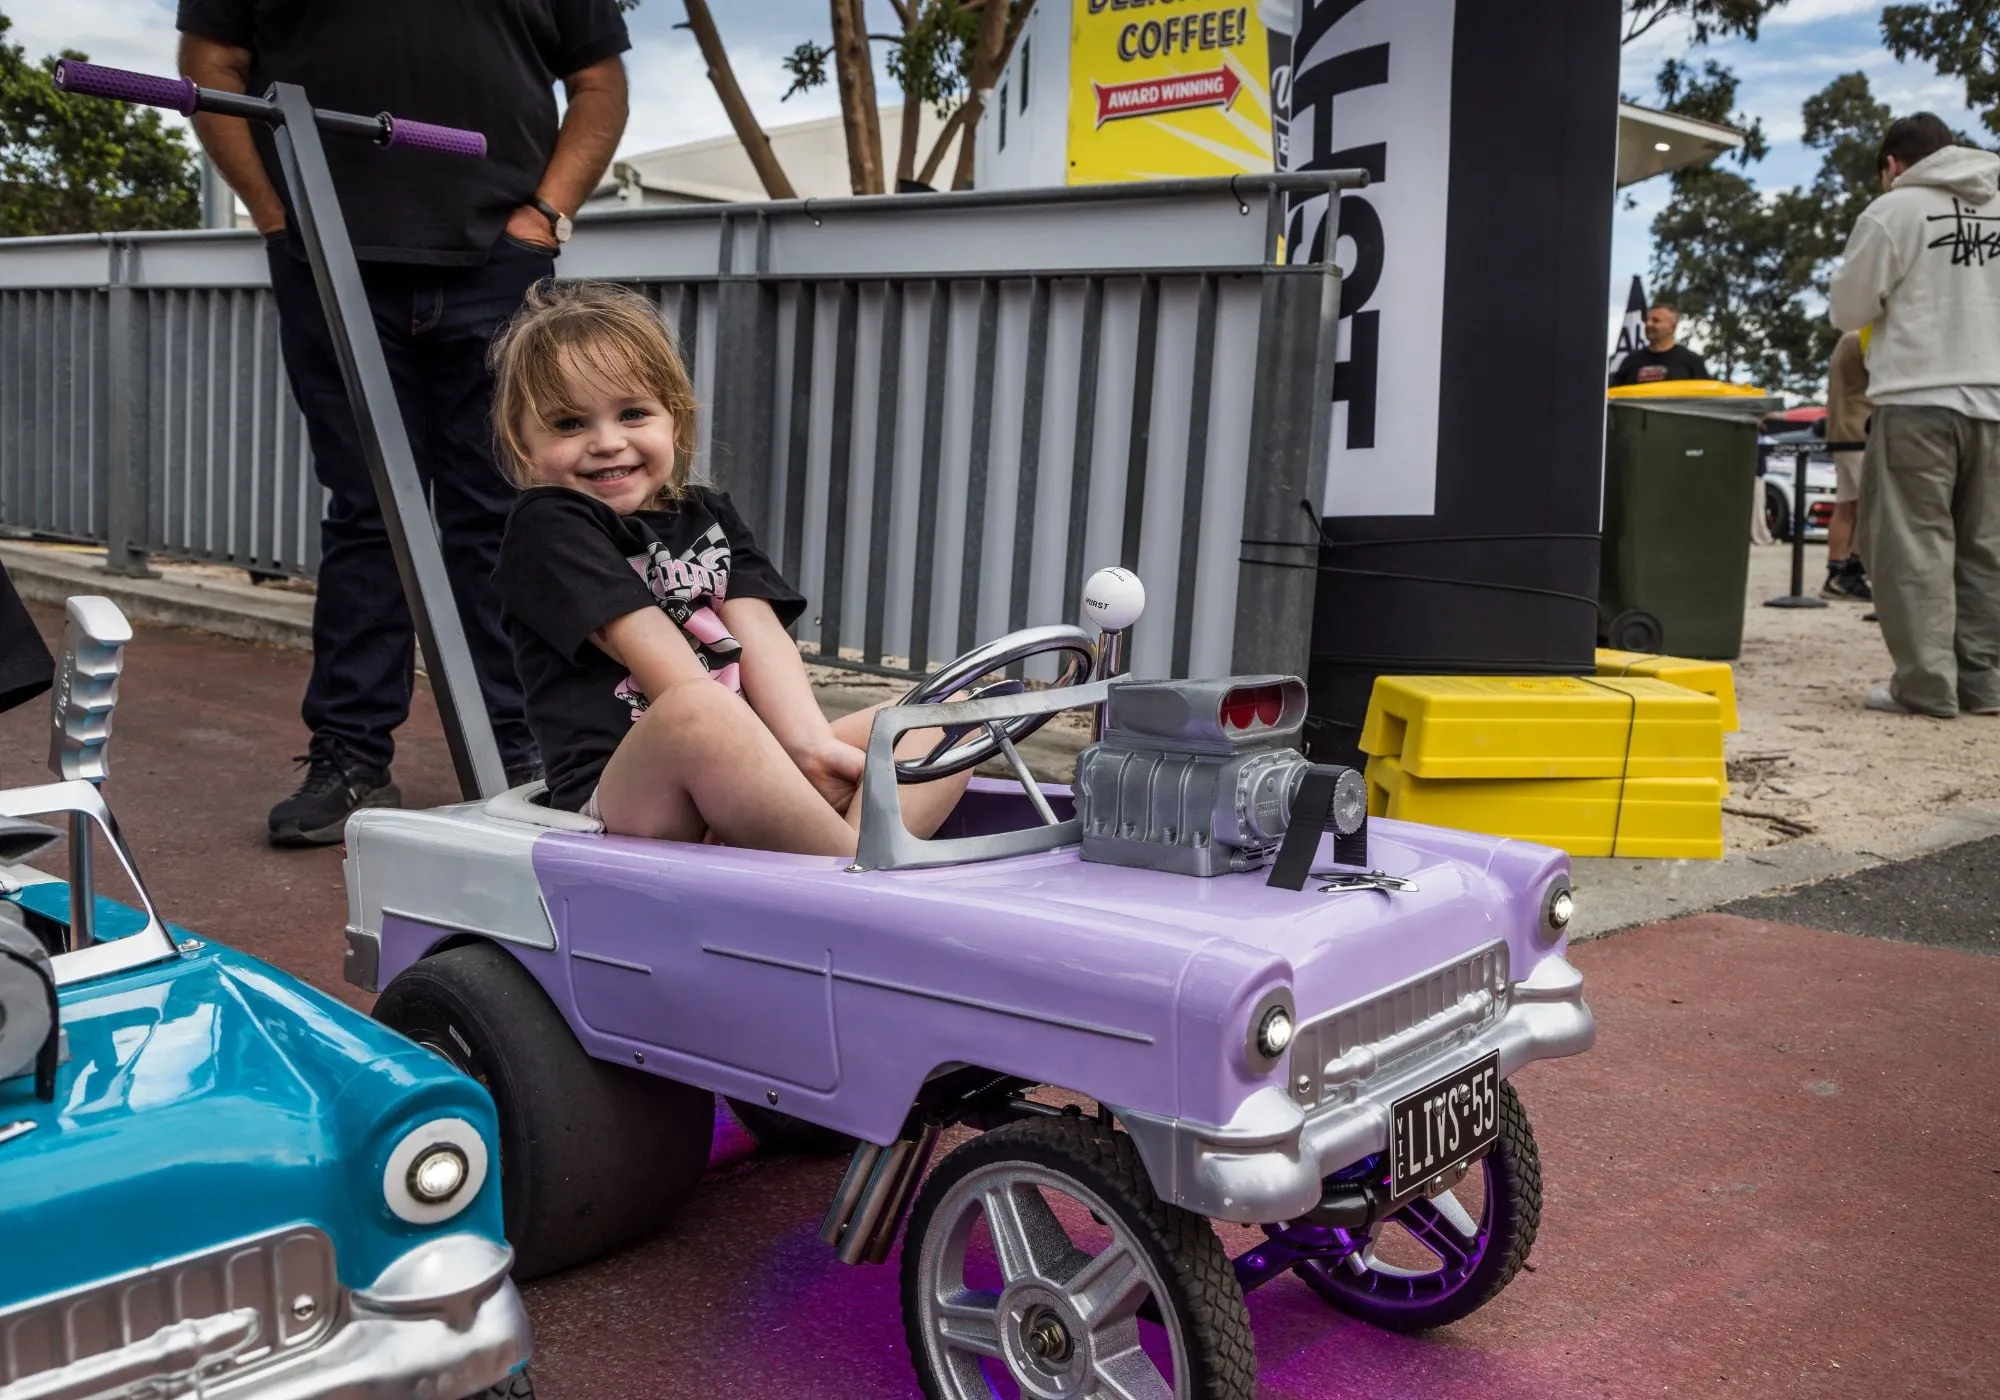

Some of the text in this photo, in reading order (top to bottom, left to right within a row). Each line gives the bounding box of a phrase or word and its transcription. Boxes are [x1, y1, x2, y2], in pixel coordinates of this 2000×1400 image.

[1118, 7, 1247, 62] COFFEE!
[1108, 76, 1225, 109] AWARD WINNING
